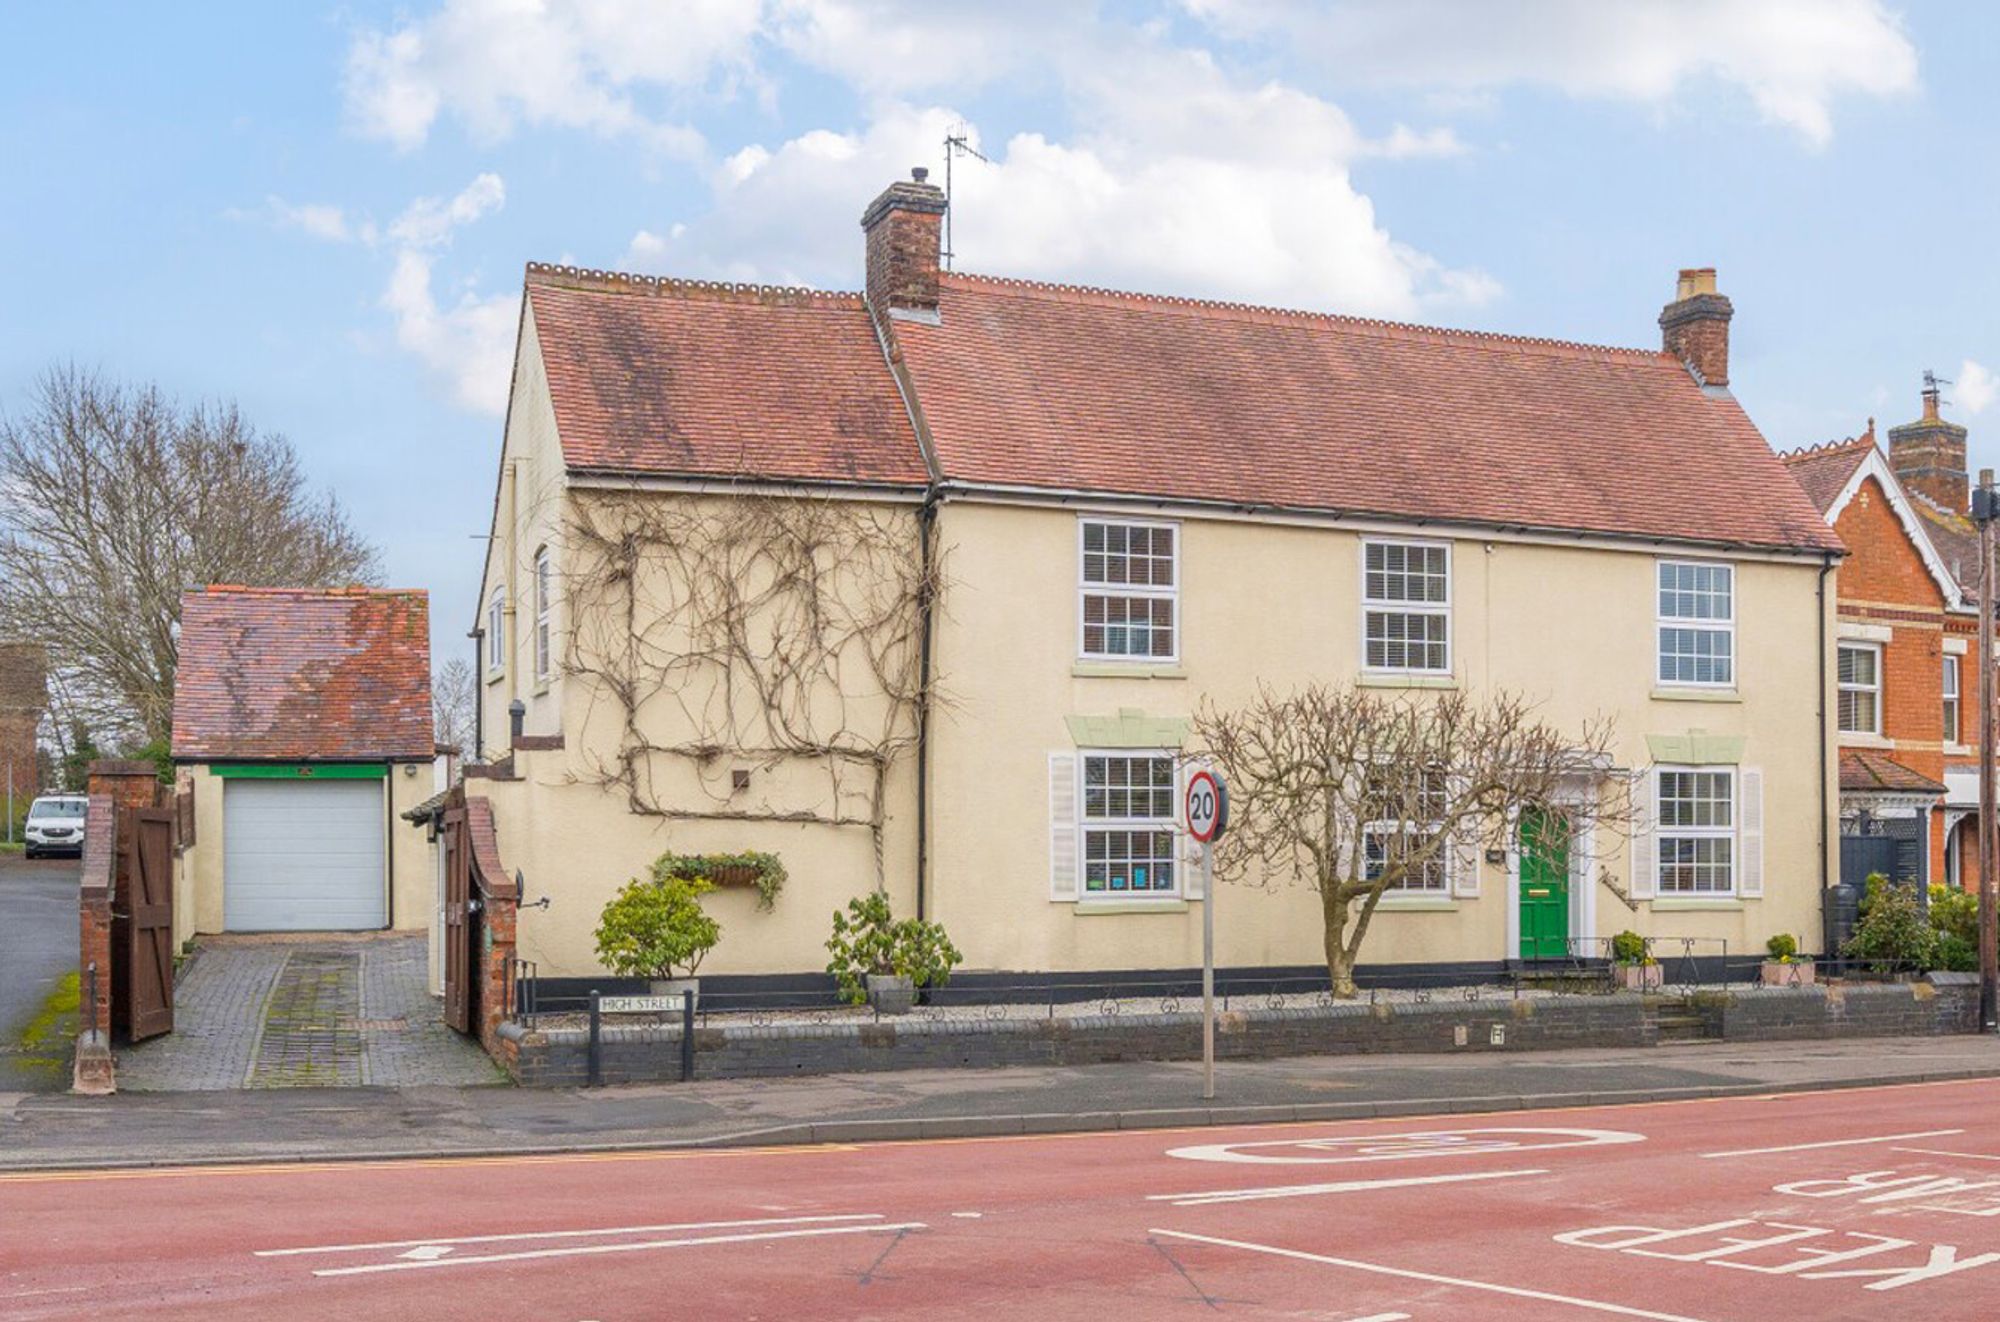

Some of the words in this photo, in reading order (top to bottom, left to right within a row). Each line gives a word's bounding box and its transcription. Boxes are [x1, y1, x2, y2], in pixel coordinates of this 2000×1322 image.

[1191, 792, 1213, 820] 20
[602, 999, 631, 1011] HIGH
[637, 998, 678, 1010] STREET
[1553, 1218, 2000, 1290] KEEP
